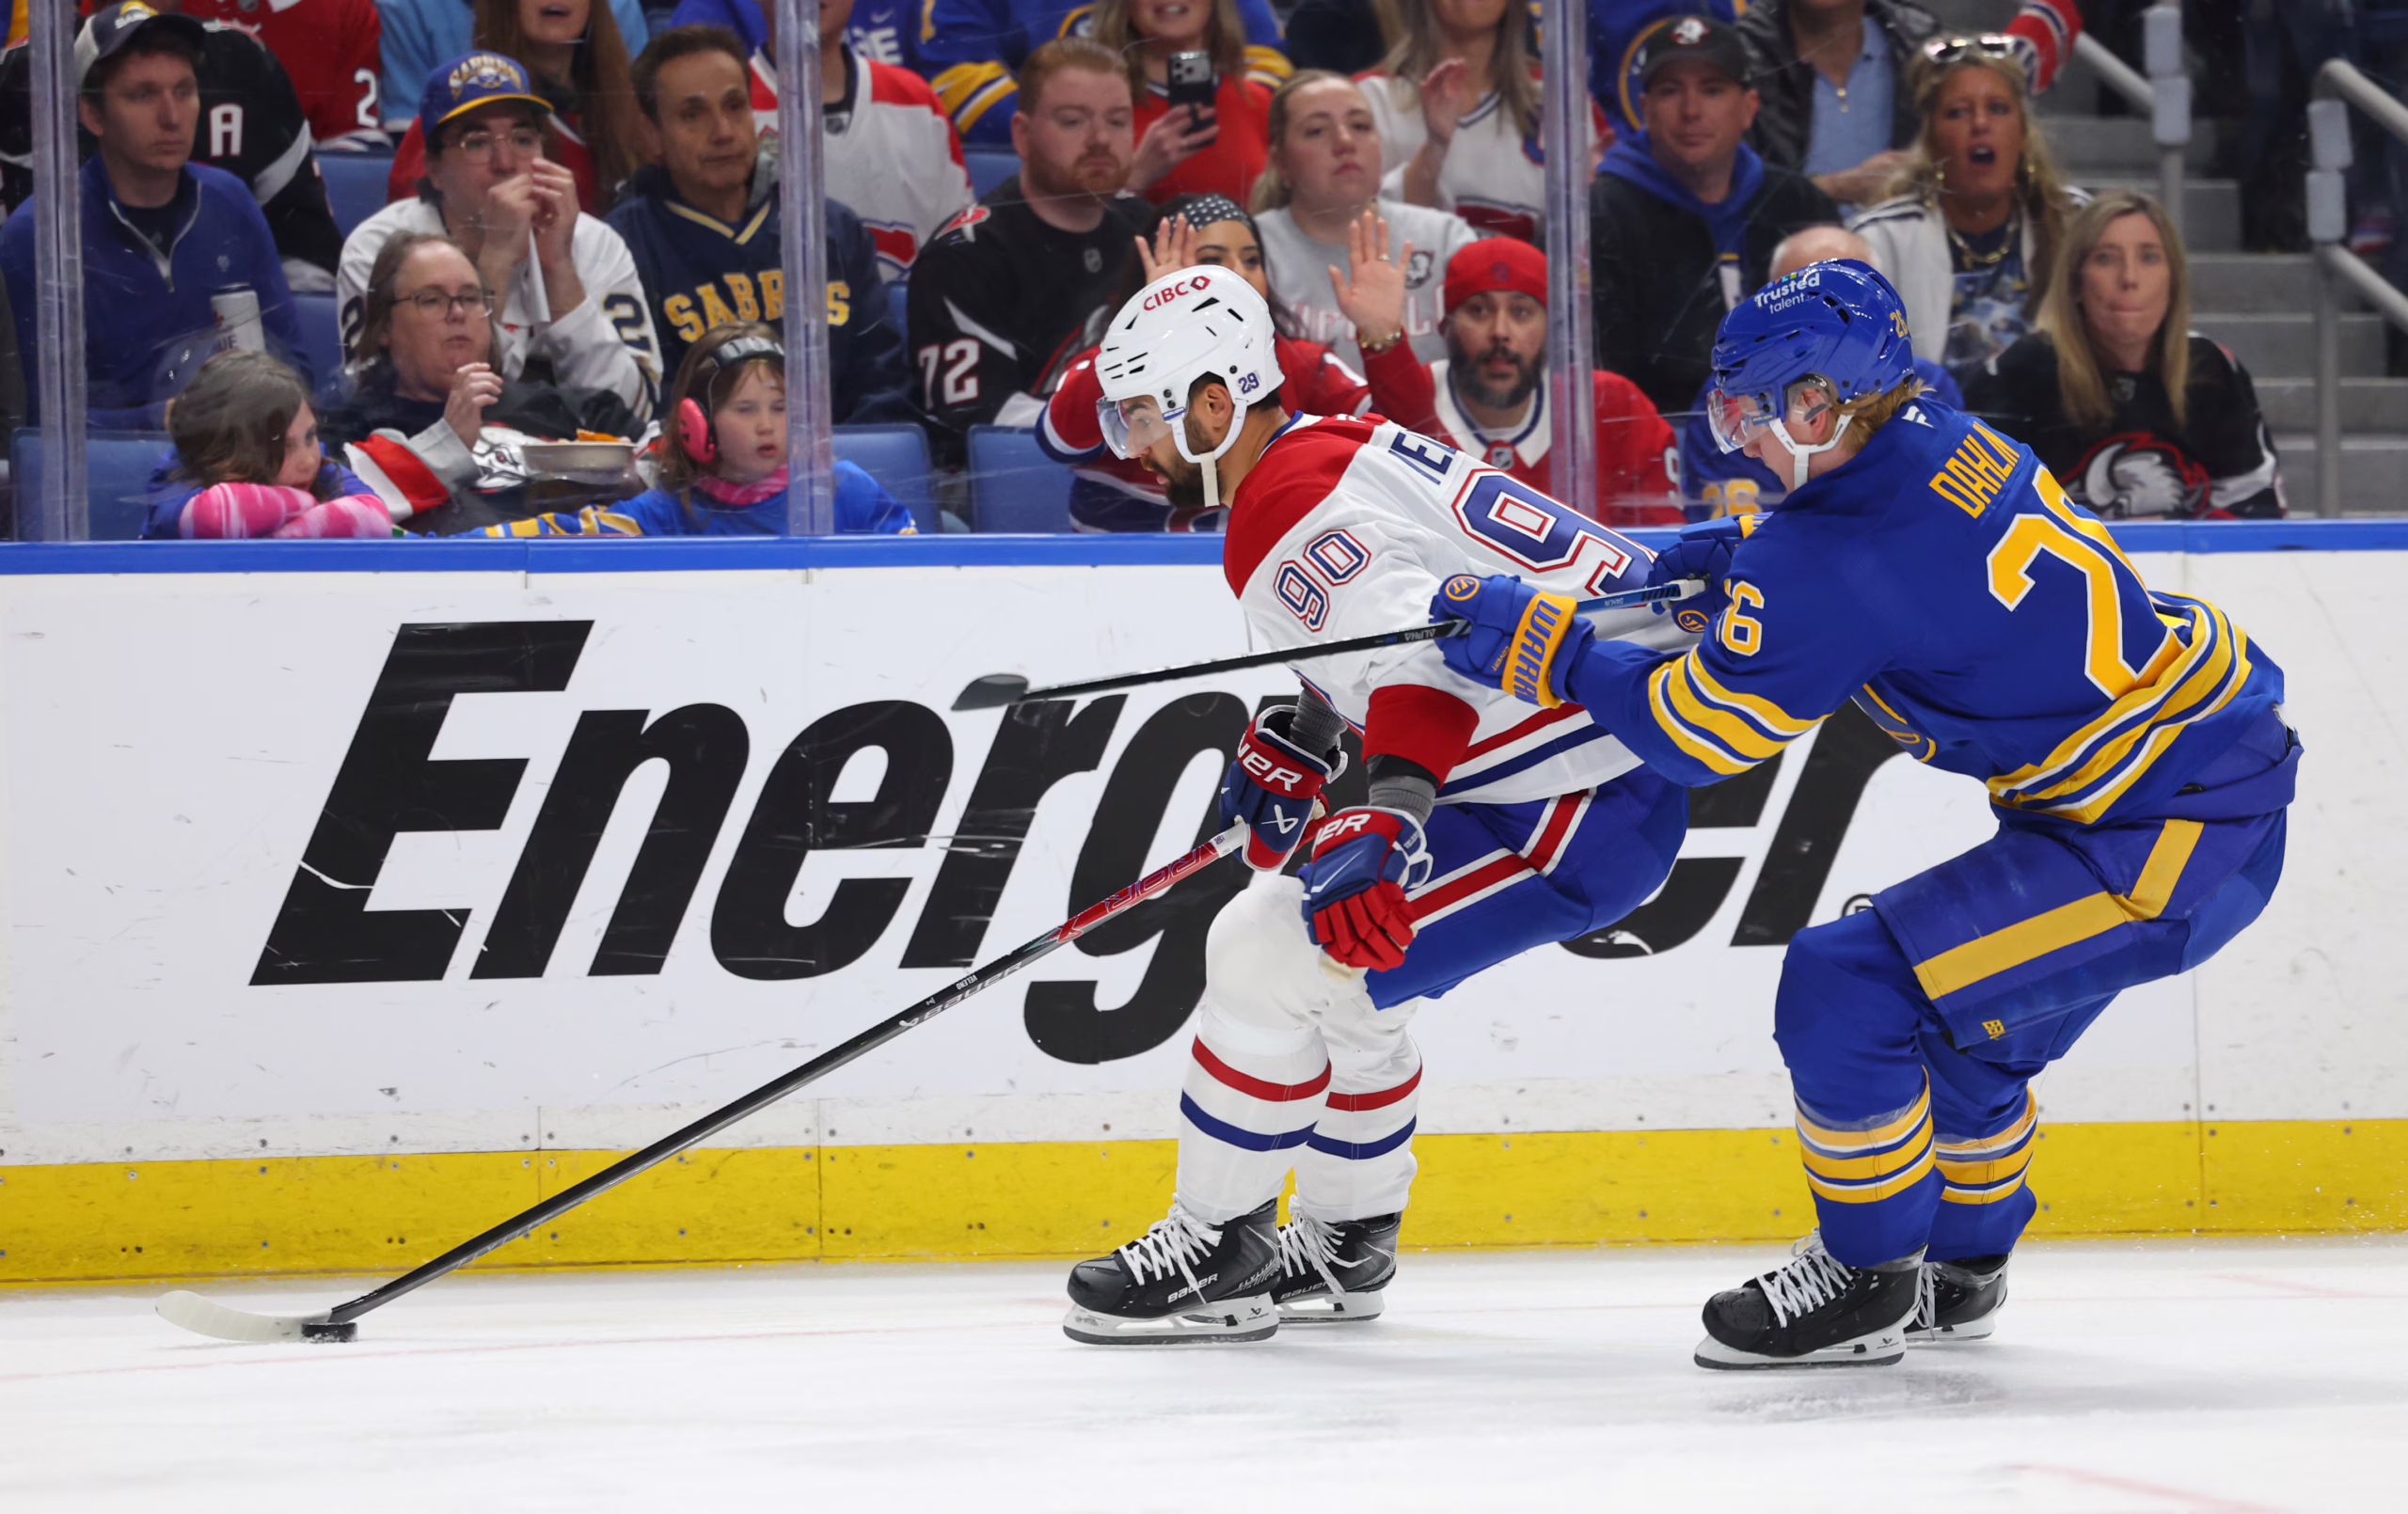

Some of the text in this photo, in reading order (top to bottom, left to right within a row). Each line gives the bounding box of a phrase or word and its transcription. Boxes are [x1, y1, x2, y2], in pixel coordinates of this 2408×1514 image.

[210, 103, 243, 156] A
[664, 269, 850, 342] SABRS
[1143, 281, 1190, 311] CIBC
[1754, 272, 1821, 308] Trusted
[1769, 292, 1805, 314] talent
[918, 339, 980, 410] 72
[1238, 372, 1259, 394] 29
[1928, 419, 2022, 519] DAHLIN
[1273, 528, 1370, 632] 90
[1717, 577, 1765, 657] 6
[956, 974, 978, 990] VELENO
